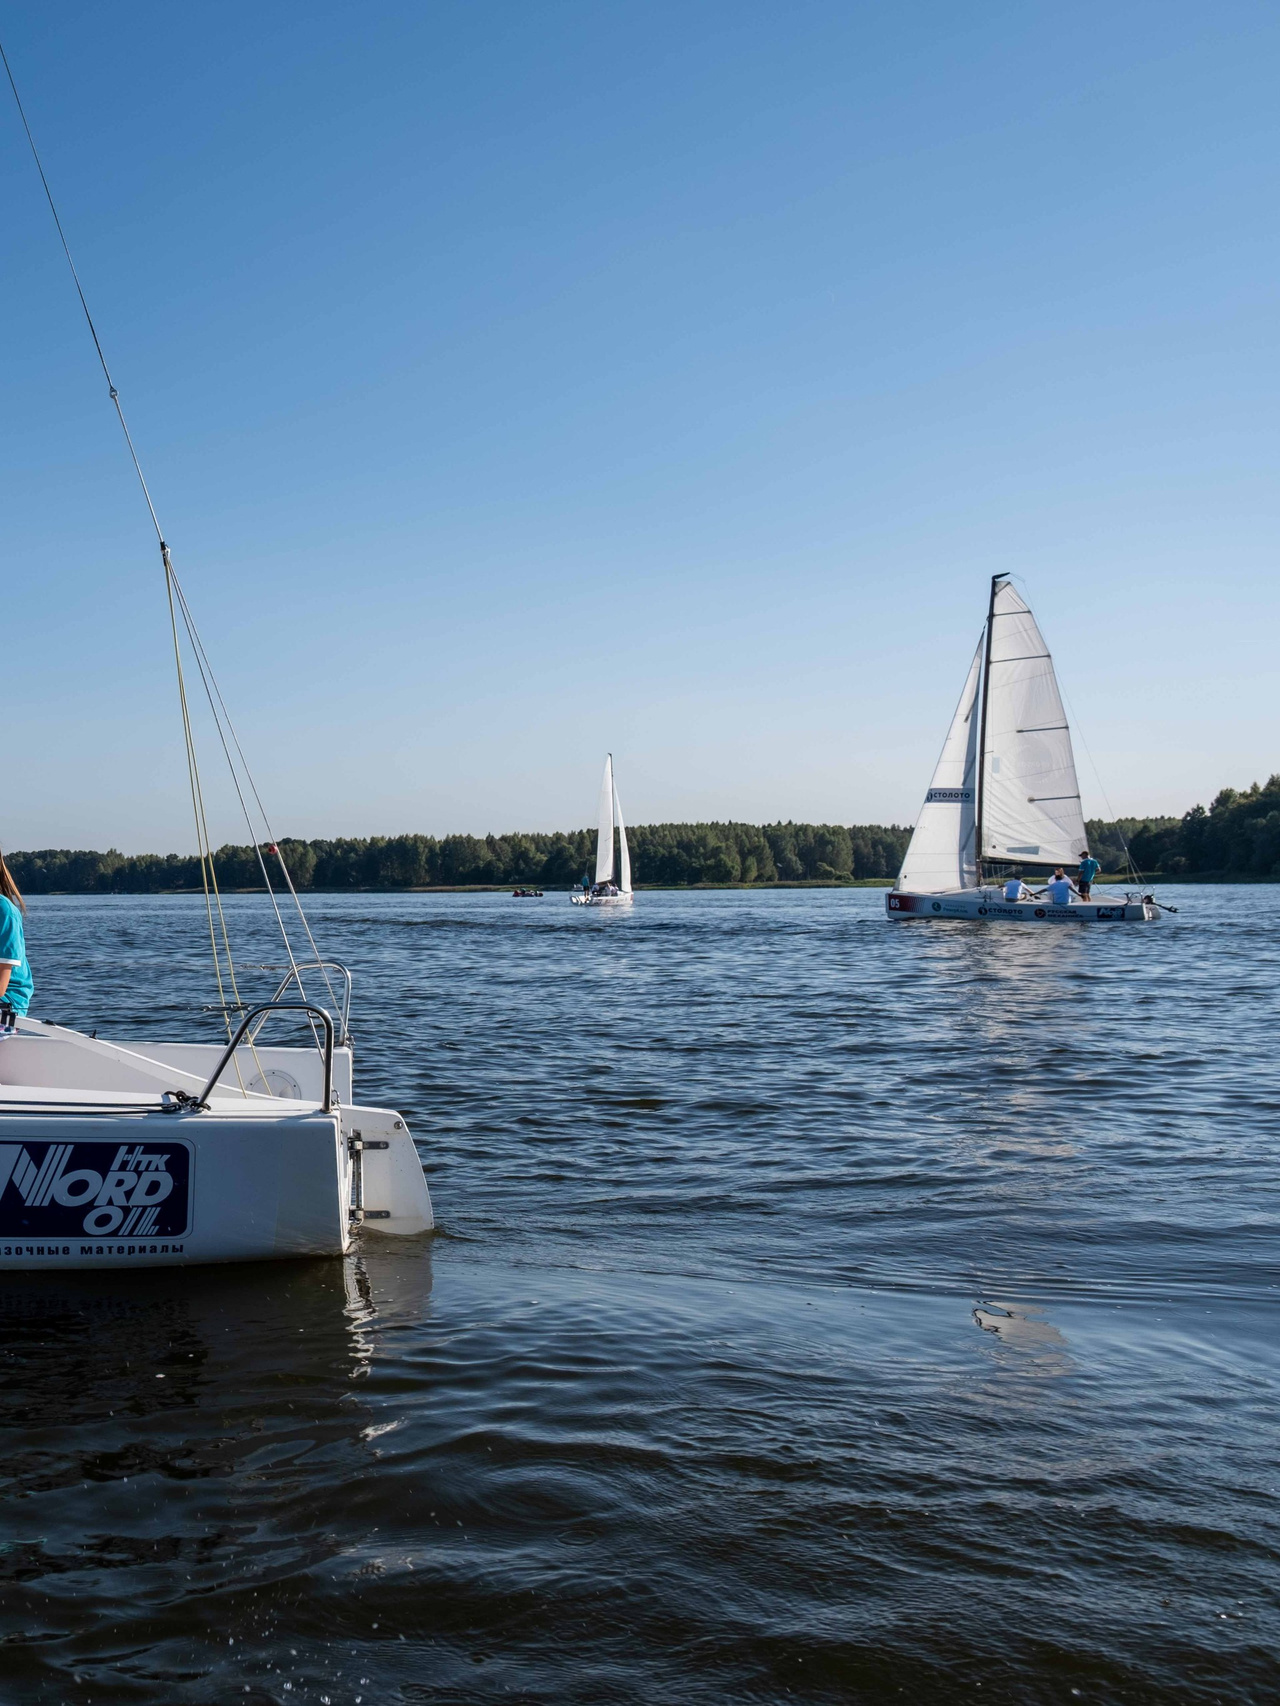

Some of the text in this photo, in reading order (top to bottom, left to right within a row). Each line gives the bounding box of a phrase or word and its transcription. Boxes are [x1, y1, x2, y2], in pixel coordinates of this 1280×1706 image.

[890, 899, 900, 908] 05
[82, 1205, 162, 1236] OIL
[80, 1244, 184, 1256] материалы
